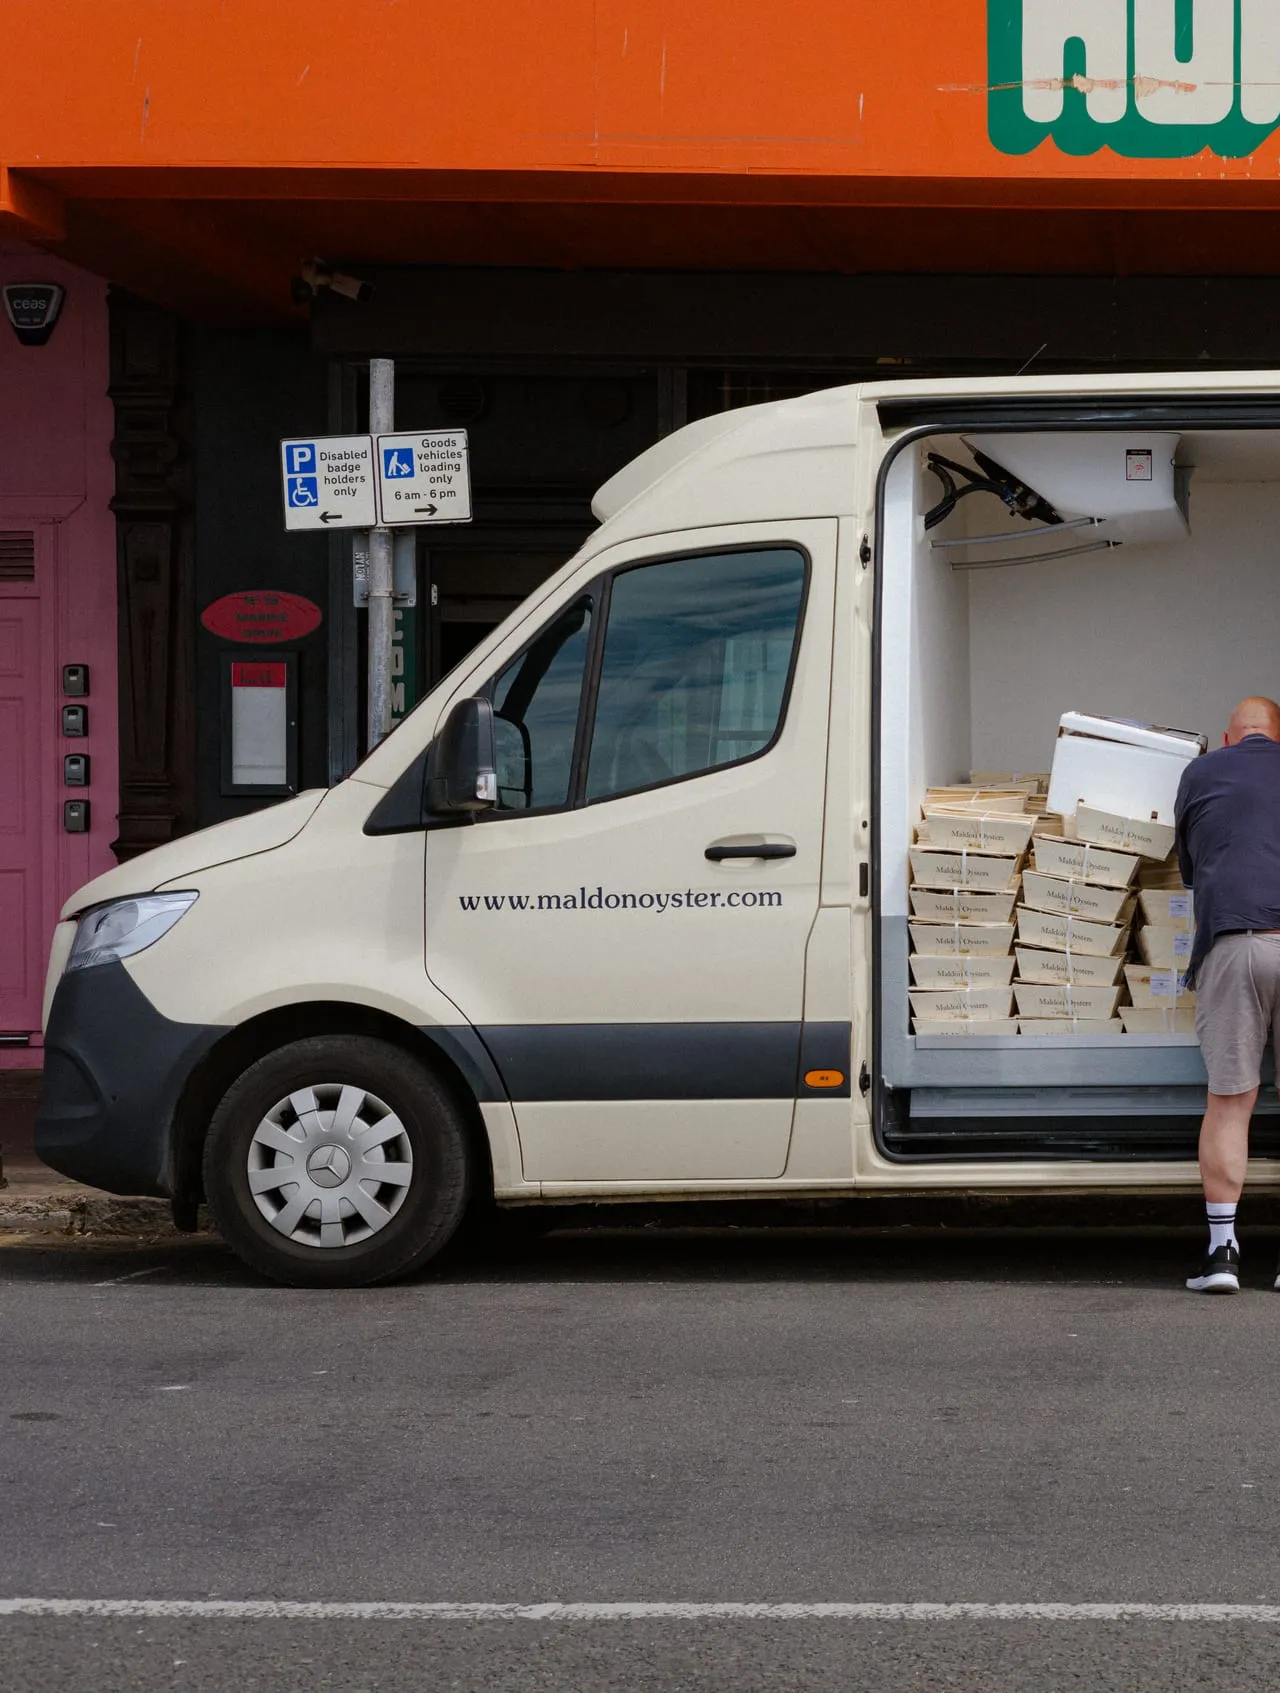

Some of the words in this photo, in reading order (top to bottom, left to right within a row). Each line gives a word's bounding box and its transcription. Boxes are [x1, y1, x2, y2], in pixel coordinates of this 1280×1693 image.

[421, 438, 457, 448] Goods
[293, 446, 311, 472] P
[319, 449, 368, 461] Disabled
[417, 450, 463, 460] vehicles
[327, 463, 361, 474] badge
[420, 461, 461, 473] loading
[324, 473, 366, 485] holders
[429, 474, 453, 485] only
[333, 486, 357, 497] only
[394, 491, 402, 500] 6
[404, 491, 421, 500] am
[430, 489, 437, 499] 6
[439, 489, 456, 500] pm
[1088, 862, 1111, 873] ysters
[458, 886, 783, 914] www.maldonoyster.com
[1071, 932, 1094, 943] ysters
[1071, 966, 1095, 976] ysters
